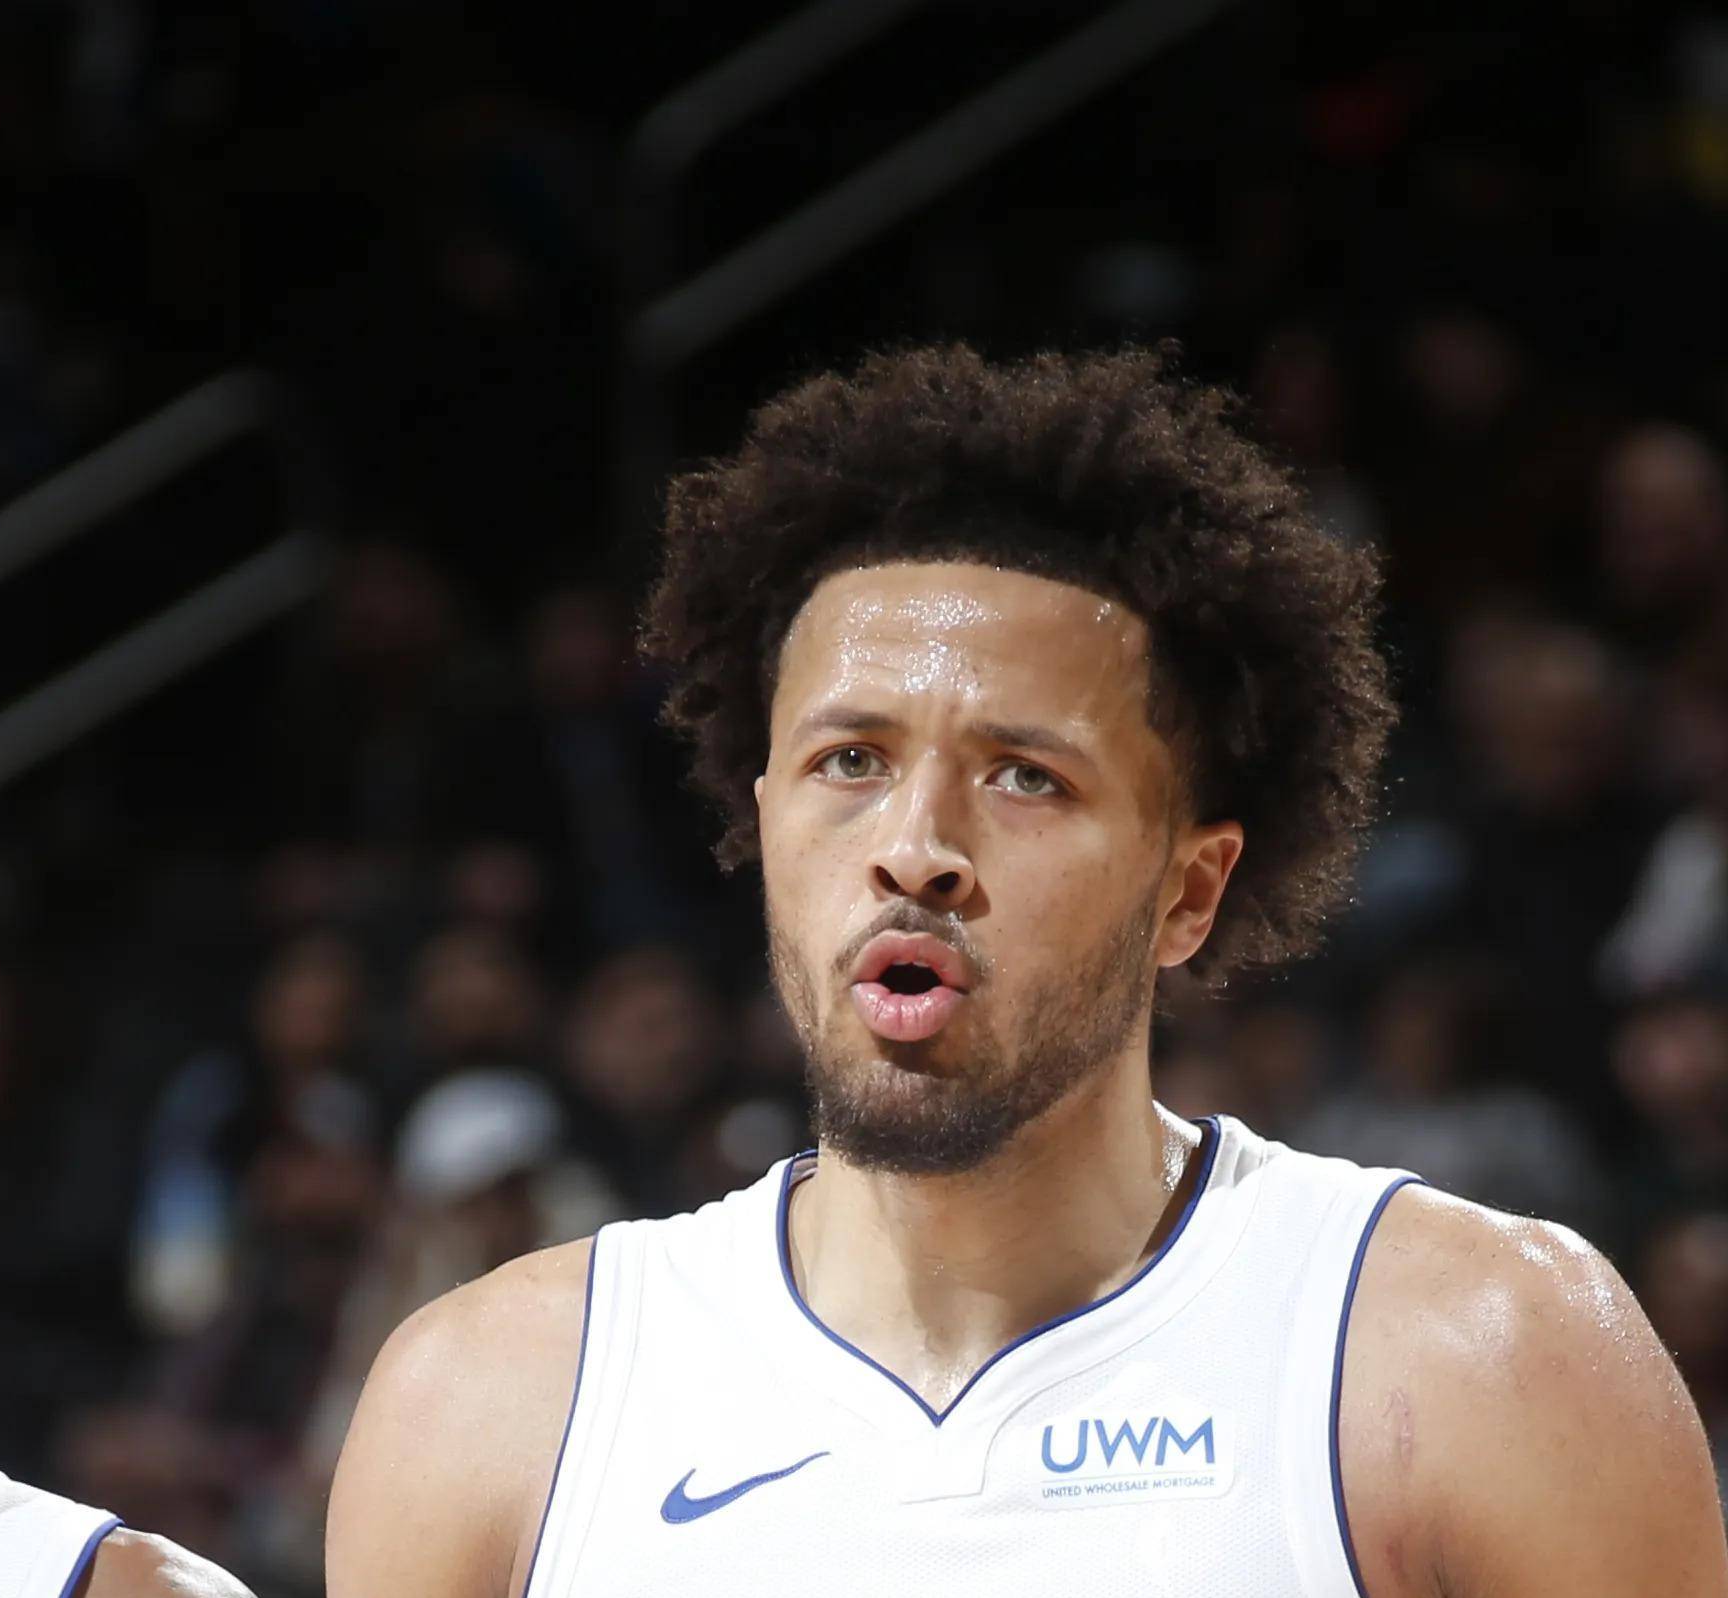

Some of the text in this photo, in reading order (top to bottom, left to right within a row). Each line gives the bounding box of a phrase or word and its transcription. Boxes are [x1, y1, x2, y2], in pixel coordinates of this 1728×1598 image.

[1041, 1417, 1215, 1473] UWM
[1042, 1476, 1214, 1498] UNITED WHOLESALE MORTGAGE
